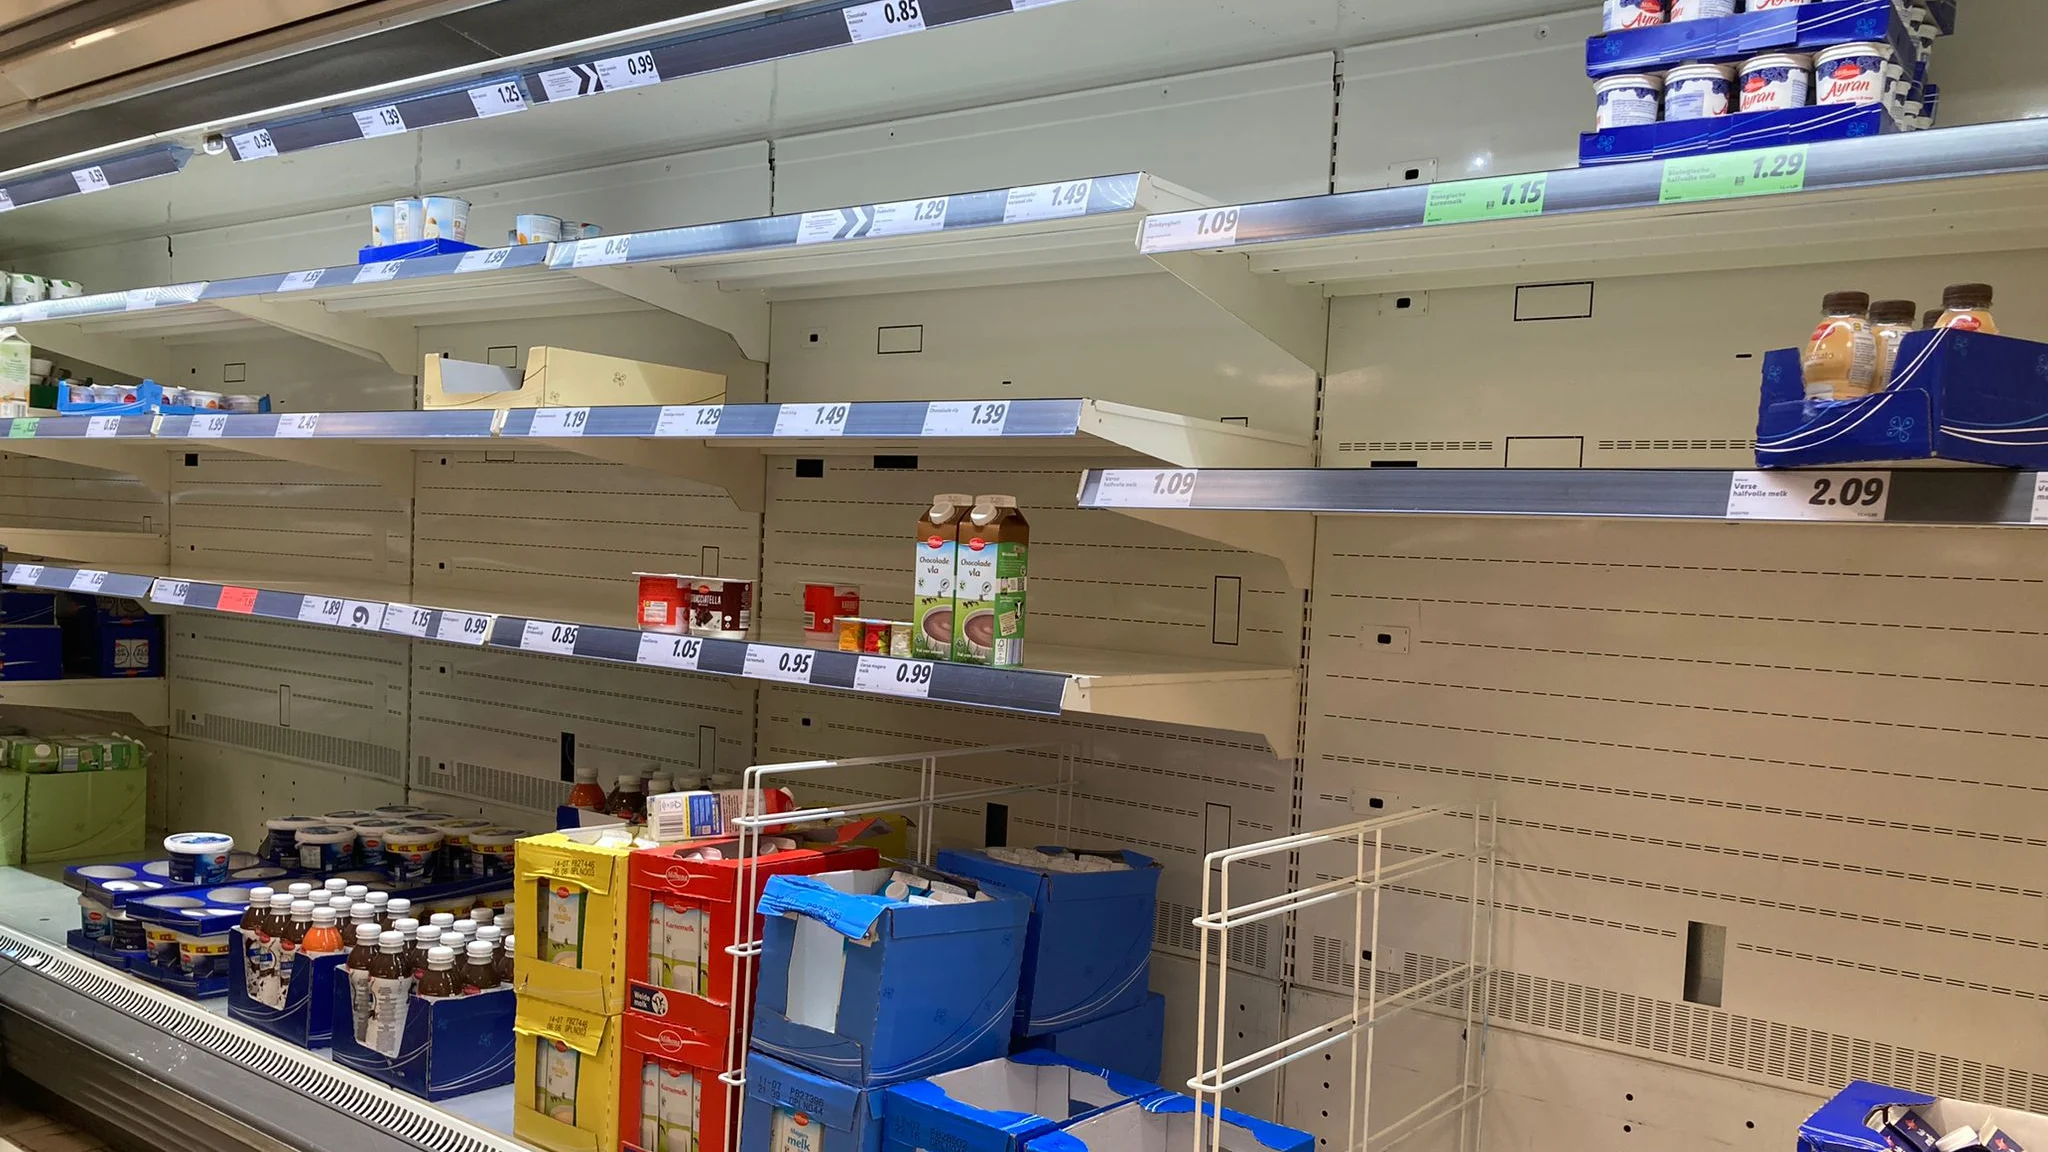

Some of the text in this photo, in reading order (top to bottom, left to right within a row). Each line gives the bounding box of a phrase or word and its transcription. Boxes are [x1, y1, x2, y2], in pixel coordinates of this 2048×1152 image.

[883, 0, 919, 24] 0.85
[627, 54, 655, 76] 0.99
[497, 85, 520, 104] 1.25
[1820, 79, 1870, 102] Ayran
[1741, 90, 1776, 111] Ayran
[379, 108, 400, 126] 1.39
[253, 132, 272, 149] 0.99
[1753, 152, 1804, 179] 1.29
[1051, 182, 1088, 207] 1.49
[1501, 179, 1542, 207] 1.15
[914, 200, 946, 221] 1.29
[1197, 209, 1238, 235] 1.09
[604, 238, 630, 255] 0.49
[484, 250, 508, 264] 1.99
[563, 411, 586, 428] 1.19
[695, 408, 721, 426] 1.29
[815, 406, 846, 425] 1.49
[971, 404, 1005, 425] 1.39
[1153, 472, 1196, 495] 1.09
[1808, 477, 1885, 506] 2.09
[1733, 489, 1767, 497] halfvolle
[919, 557, 949, 565] Chocolade
[927, 565, 939, 574] vla
[960, 558, 992, 567] Chocolade
[969, 568, 981, 577] vla
[173, 582, 188, 598] 1.99
[322, 599, 341, 616] 1.89
[412, 610, 430, 627] 1.15
[464, 617, 488, 634] 0.99
[551, 626, 578, 644] 0.85
[672, 639, 701, 658] 1.05
[779, 652, 812, 673] 0.95
[896, 663, 931, 684] 0.99
[665, 921, 695, 933] Karnemelk
[661, 1082, 688, 1097] Karnemelk
[758, 1075, 782, 1089] 11-07
[787, 1136, 811, 1151] melk
